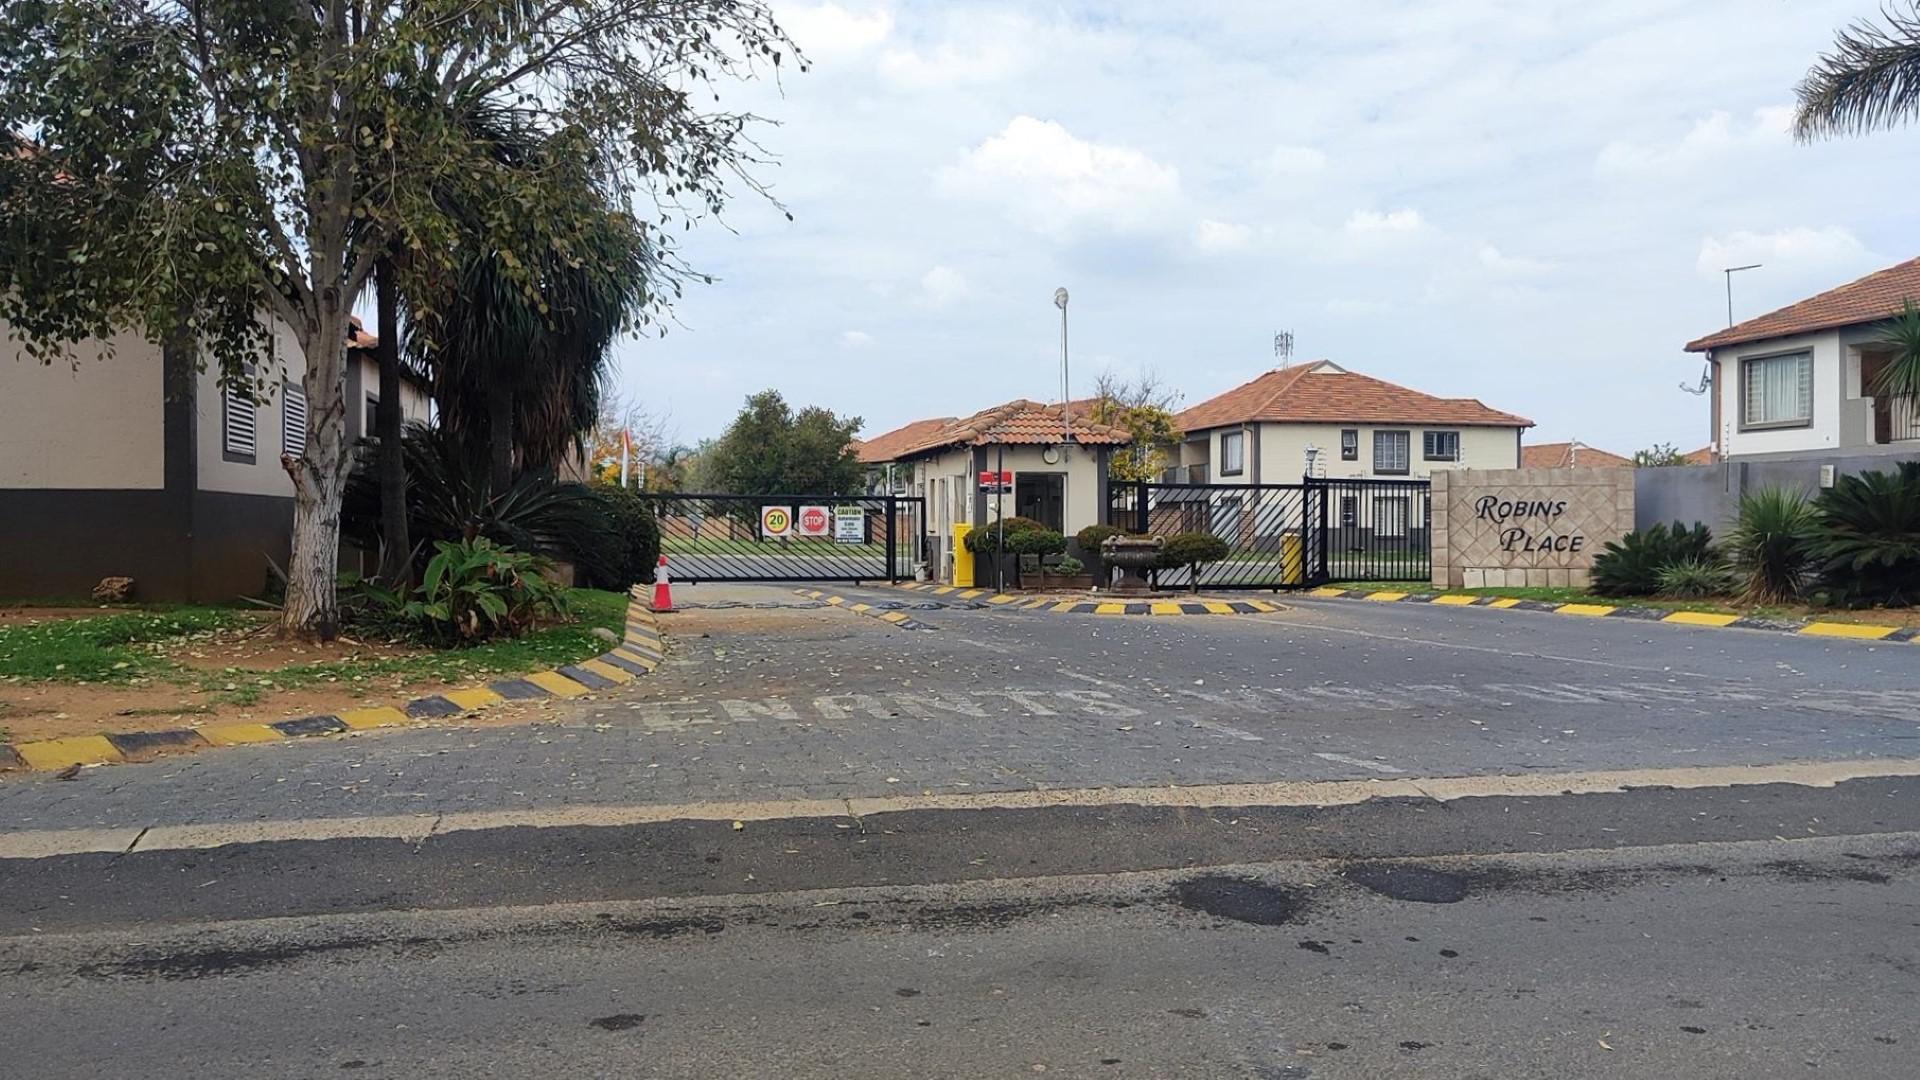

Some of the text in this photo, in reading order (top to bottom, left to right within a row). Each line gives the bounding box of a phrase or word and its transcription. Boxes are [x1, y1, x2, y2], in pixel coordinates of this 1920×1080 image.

[769, 514, 784, 525] 20
[804, 516, 824, 526] STOP
[1500, 527, 1584, 553] PLACE
